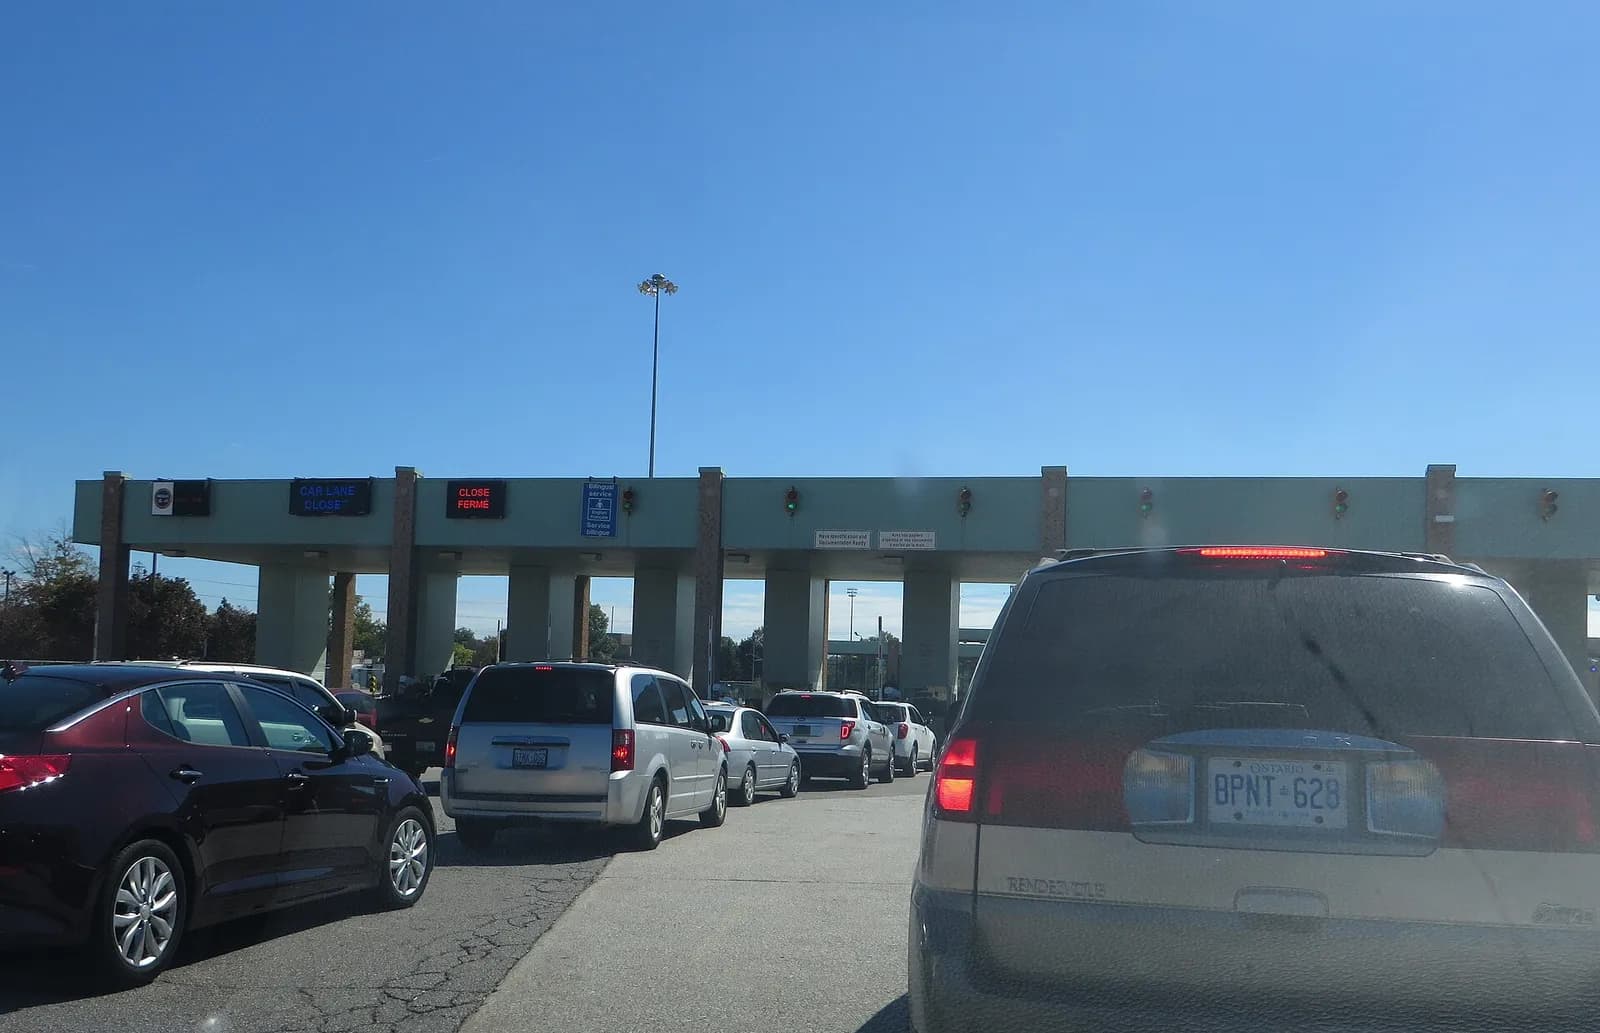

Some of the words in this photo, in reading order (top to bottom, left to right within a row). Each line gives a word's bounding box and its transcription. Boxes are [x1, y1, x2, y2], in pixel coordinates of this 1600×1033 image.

[300, 486, 323, 496] CAR
[327, 485, 356, 496] LANE
[459, 488, 490, 497] CLOSE
[304, 499, 347, 510] CLOSE
[1250, 763, 1304, 774] ONTARIO
[1293, 777, 1340, 809] 628
